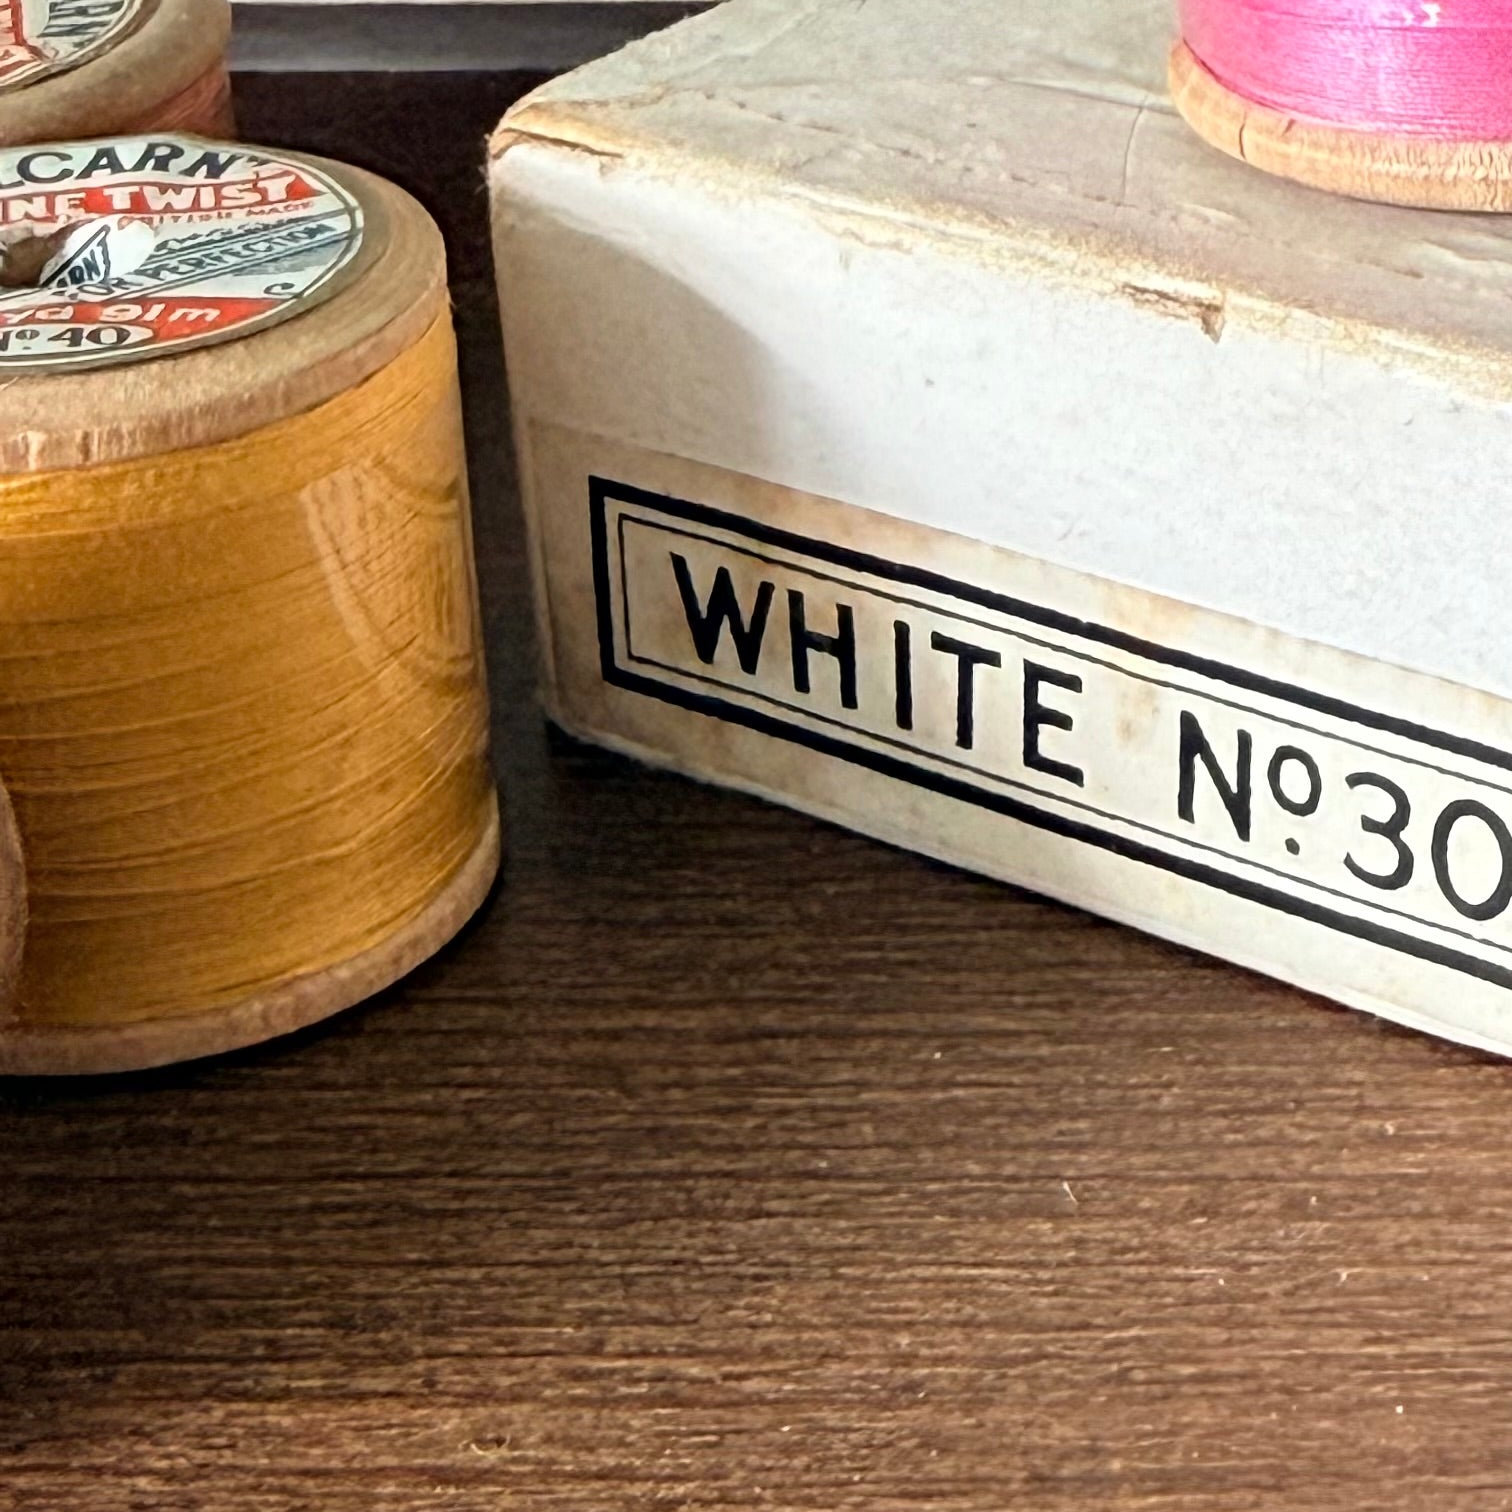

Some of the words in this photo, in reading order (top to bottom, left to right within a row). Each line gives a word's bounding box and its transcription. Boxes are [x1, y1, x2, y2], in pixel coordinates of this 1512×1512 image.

[103, 175, 297, 213] TWIST
[98, 303, 221, 325] 91m
[669, 550, 1086, 788] WHITE
